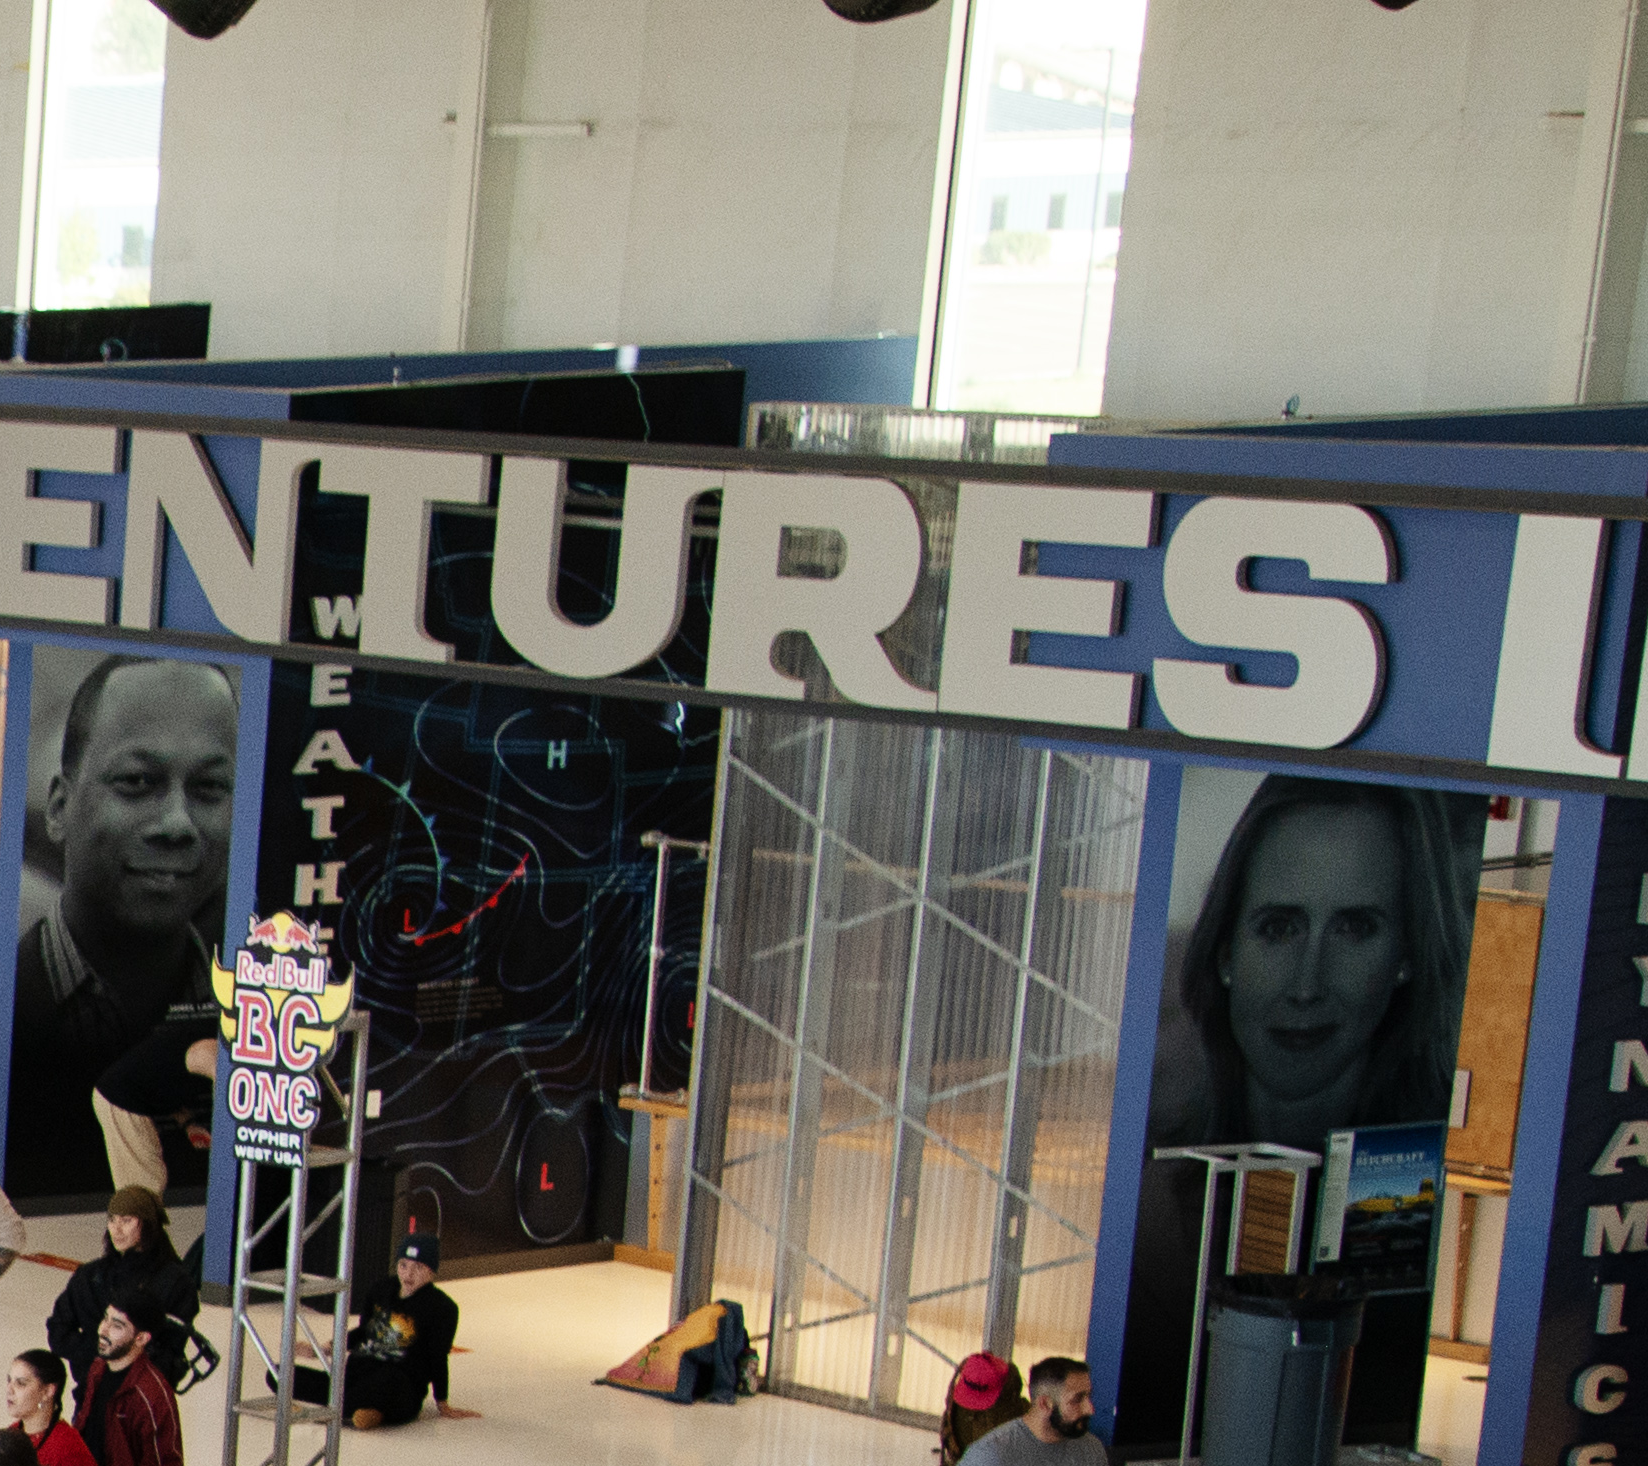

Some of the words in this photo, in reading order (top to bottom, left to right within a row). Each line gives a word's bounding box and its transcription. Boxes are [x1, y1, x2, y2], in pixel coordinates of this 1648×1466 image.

[1487, 512, 1648, 782] I
[292, 594, 362, 970] WEATH
[235, 949, 278, 986] Red
[279, 954, 326, 996] Bull
[231, 988, 320, 1072] BC
[228, 1066, 319, 1130] ONE
[234, 1144, 271, 1163] WEST
[273, 1149, 304, 1168] USA
[237, 1126, 302, 1150] CYPHER
